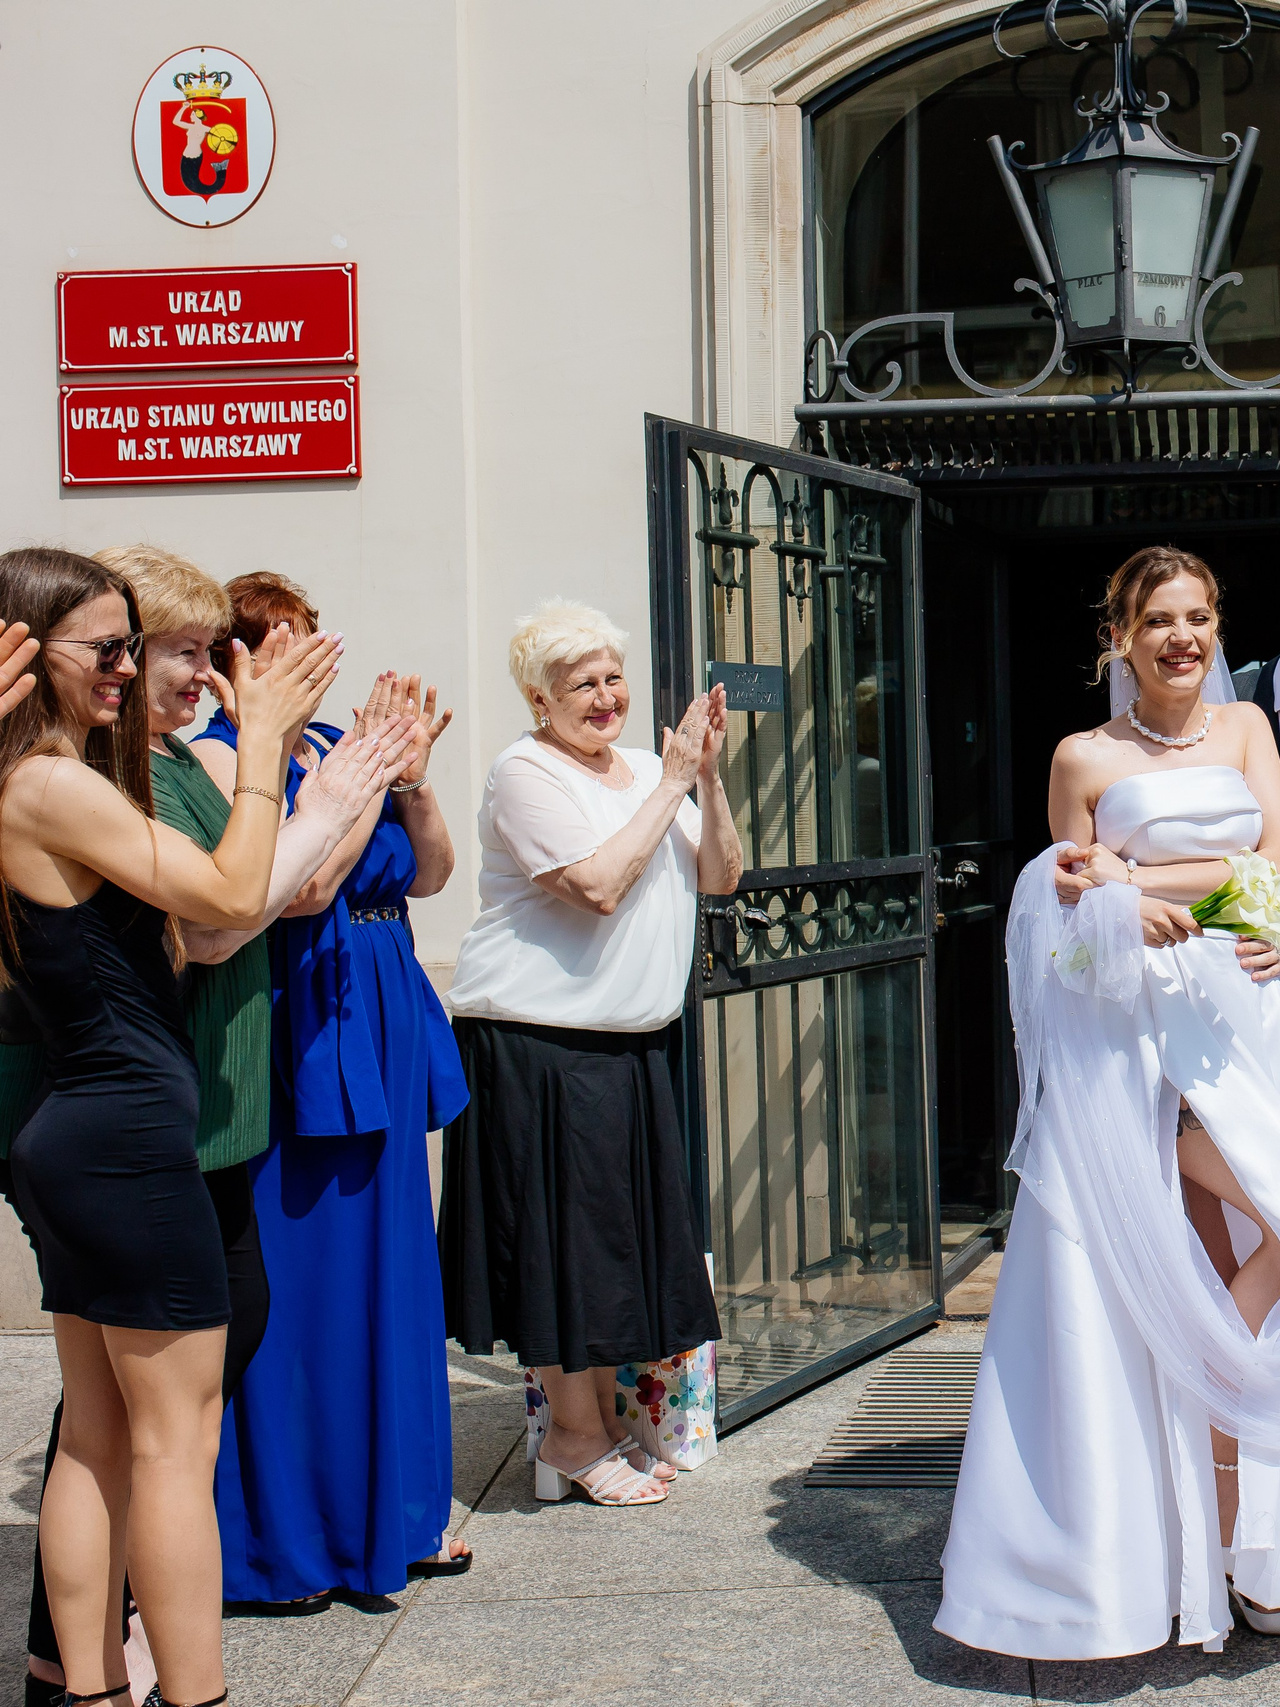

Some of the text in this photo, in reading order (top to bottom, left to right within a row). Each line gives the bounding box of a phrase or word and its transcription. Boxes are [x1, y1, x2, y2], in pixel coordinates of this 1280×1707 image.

[1077, 272, 1187, 289] PLAC ZAMKOWY
[167, 288, 243, 317] URZĄD
[1154, 305, 1167, 329] 6
[108, 319, 305, 348] M.ST. WARSZAWY
[70, 398, 347, 433] URZĄD STANU CYWILNEGO
[117, 432, 302, 461] M.ST. WARSZAWY
